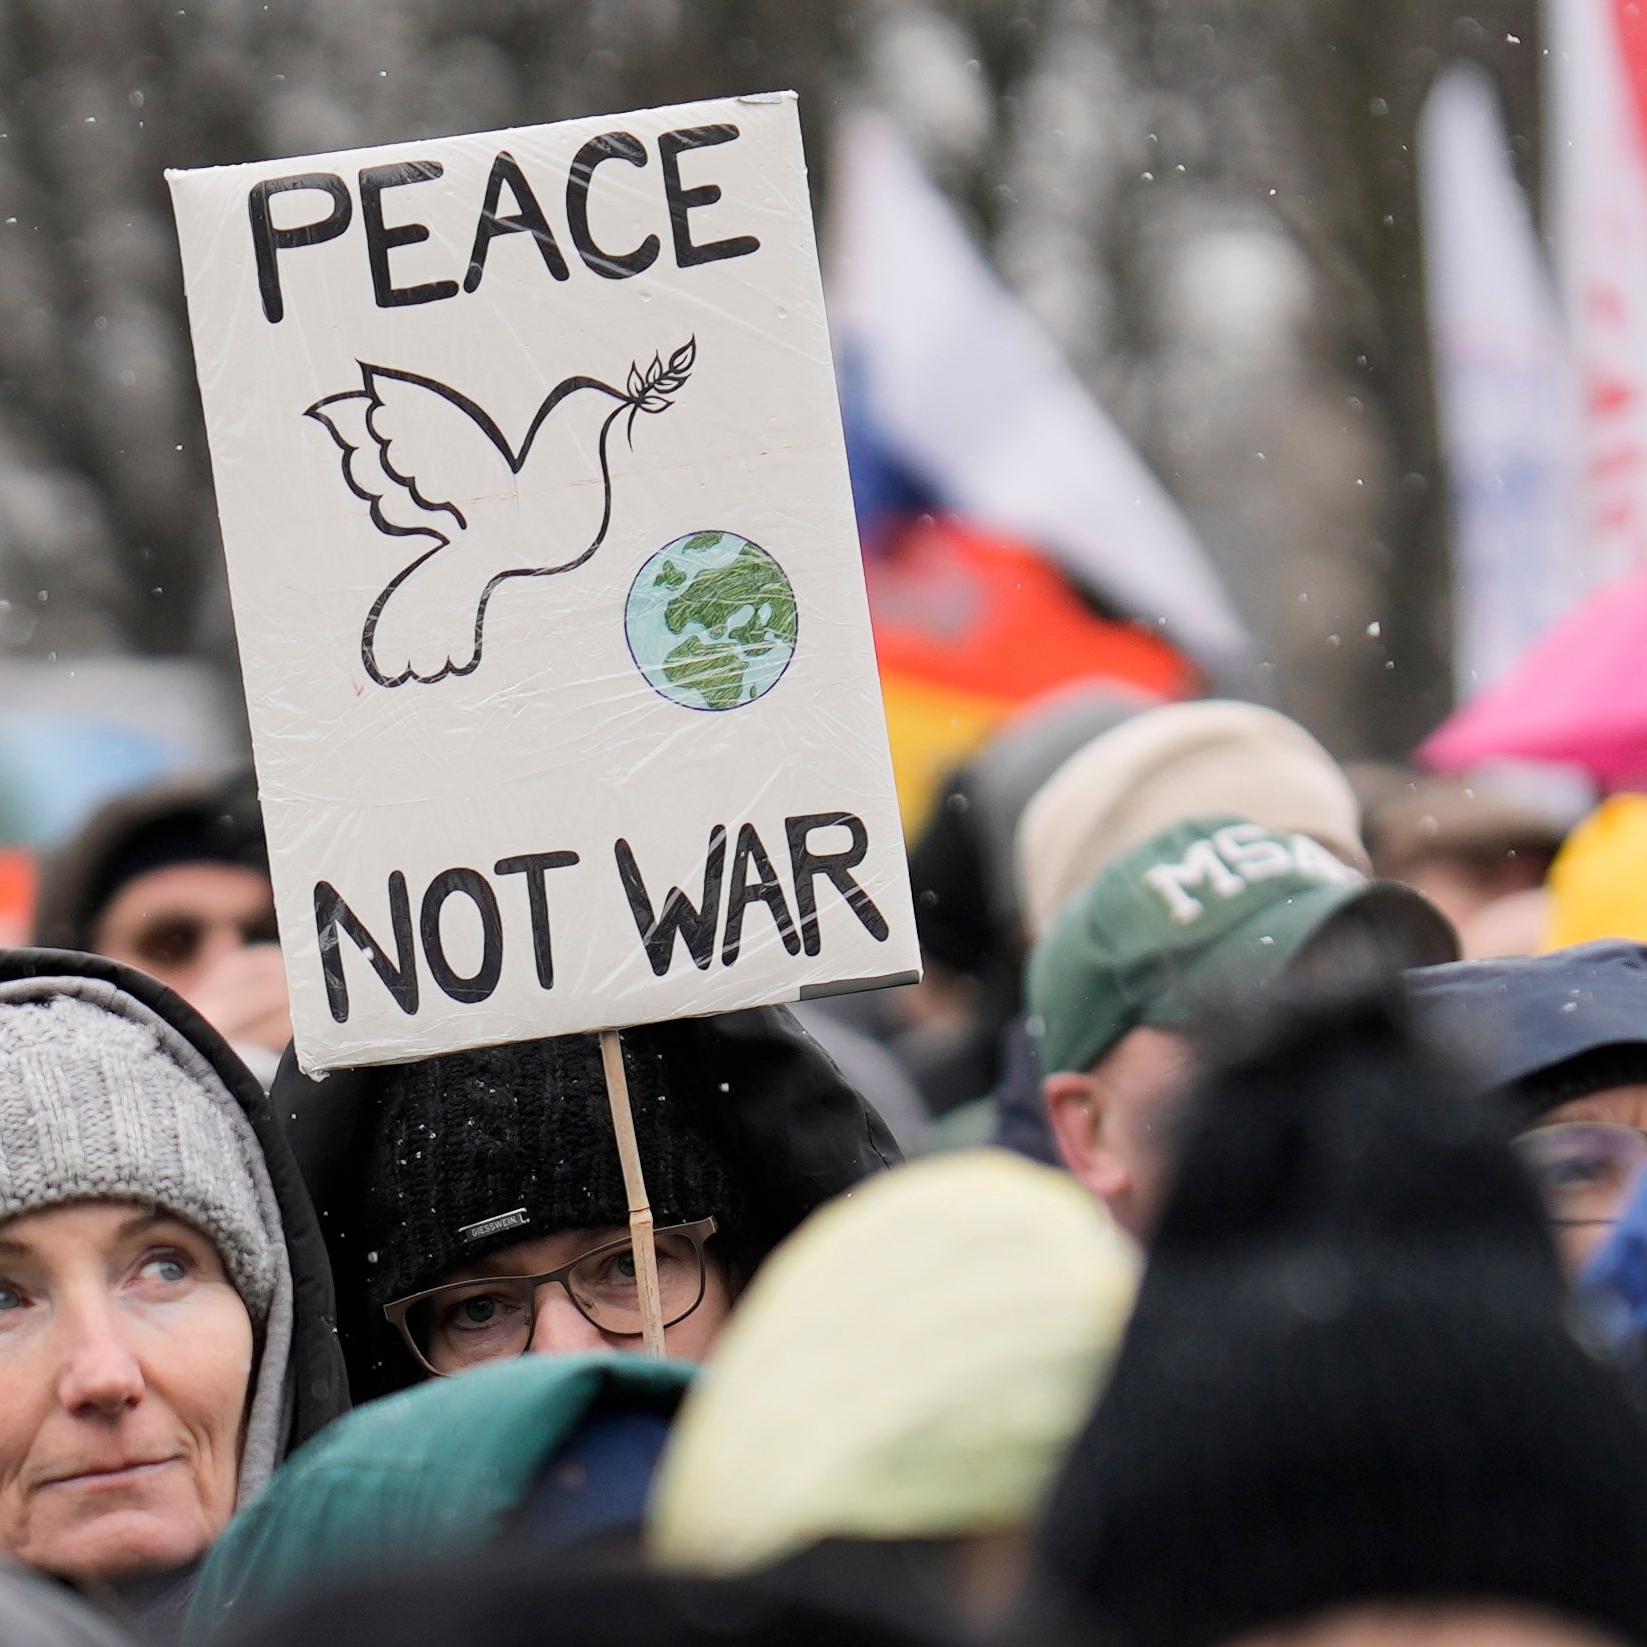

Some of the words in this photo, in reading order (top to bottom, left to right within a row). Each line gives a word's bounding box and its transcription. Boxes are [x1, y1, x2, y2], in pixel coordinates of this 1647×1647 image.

[248, 123, 761, 325] PEACE
[313, 849, 580, 1025] NOT
[614, 810, 891, 977] WAR
